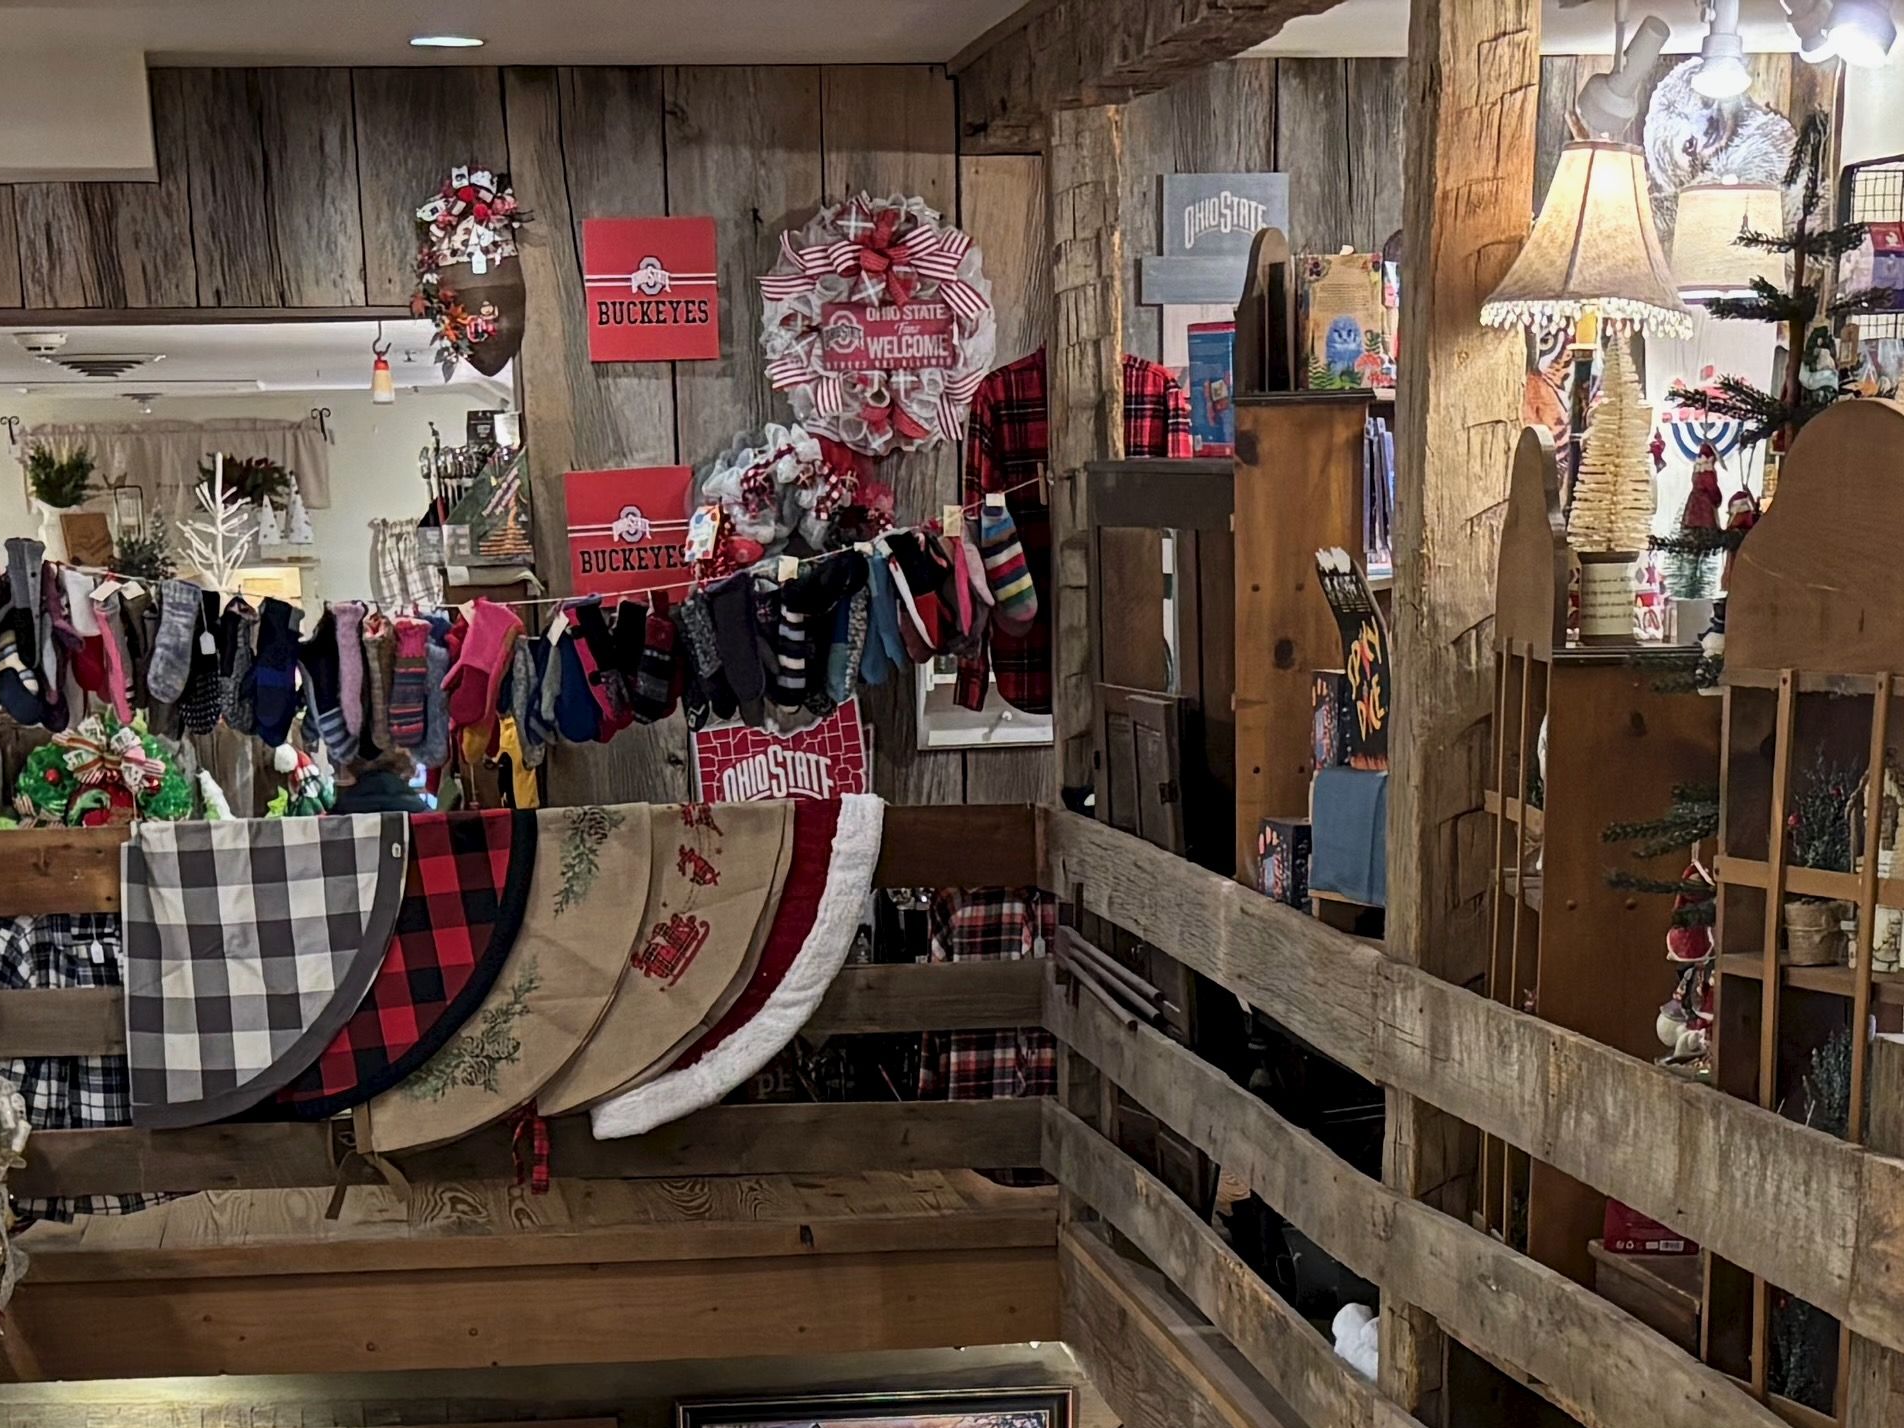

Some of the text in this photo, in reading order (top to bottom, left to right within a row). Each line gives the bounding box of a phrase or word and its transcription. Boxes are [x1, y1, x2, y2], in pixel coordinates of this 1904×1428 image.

[1184, 191, 1268, 249] OHIO STATE
[597, 298, 710, 326] BUCKEYES
[866, 304, 946, 322] OHIO STATE
[867, 334, 949, 359] WELCOME
[579, 545, 688, 574] BUCKEYES
[1356, 673, 1385, 742] DICE
[723, 745, 834, 803] OHIO STATE
